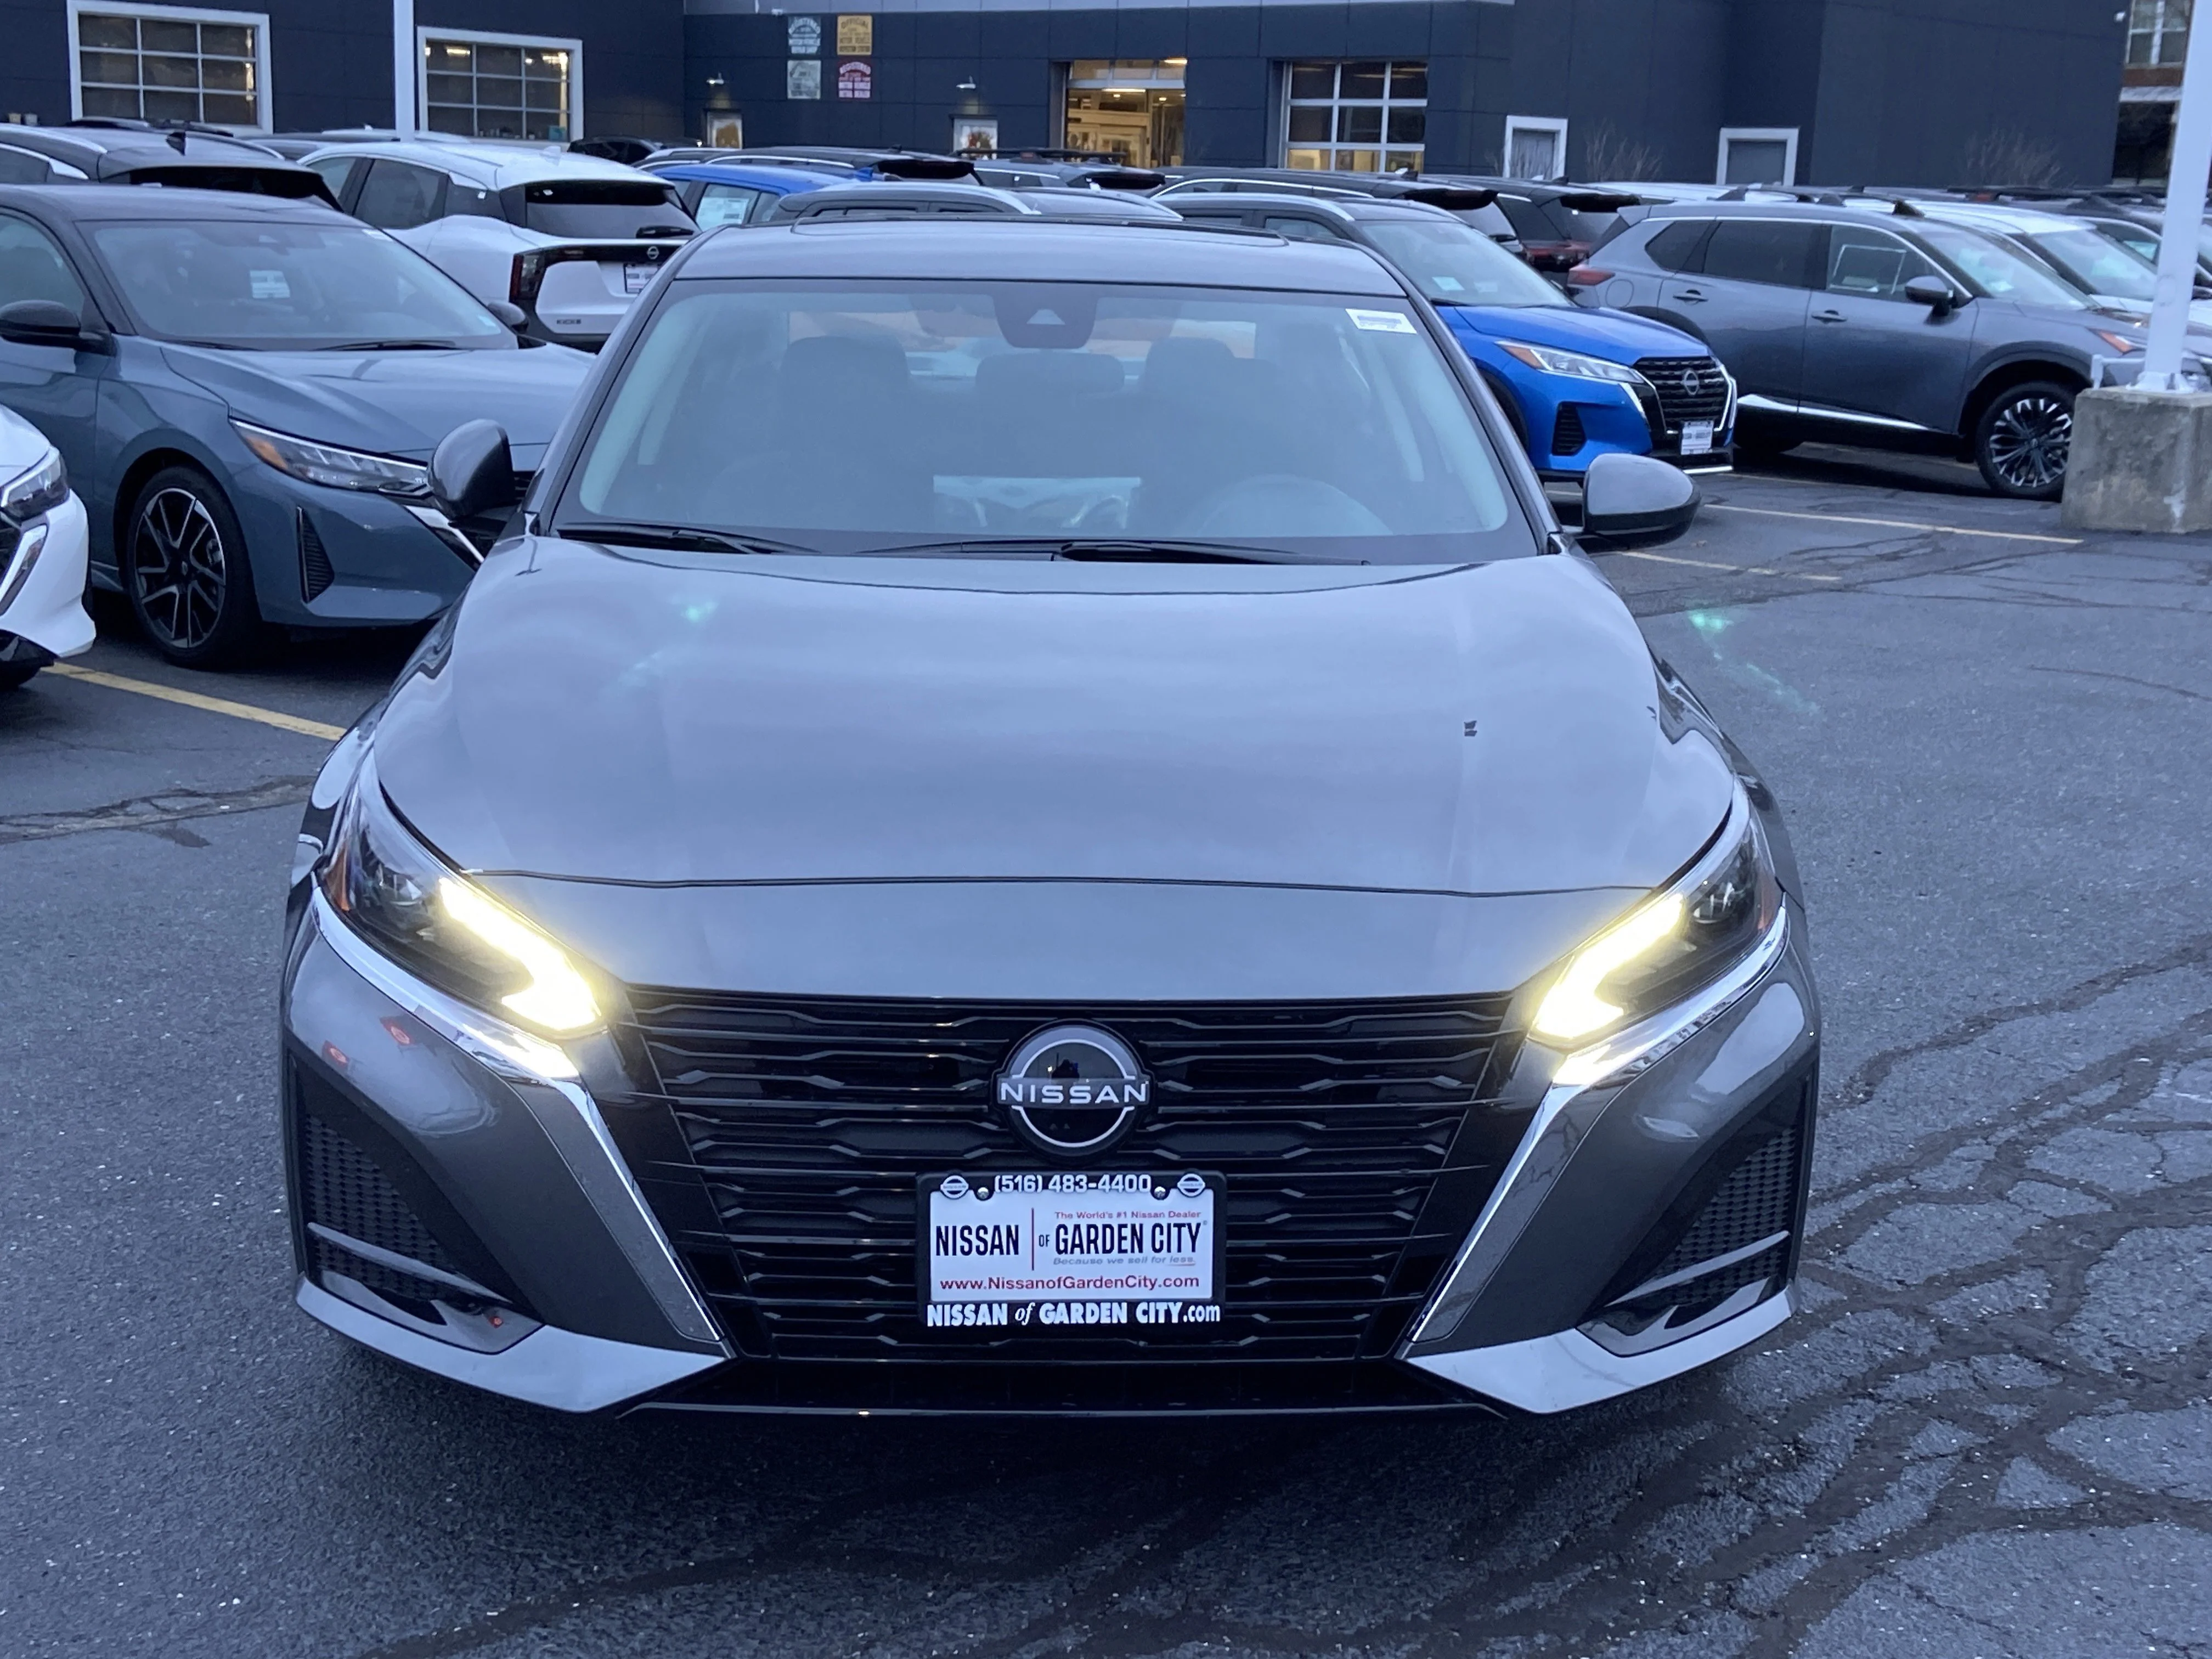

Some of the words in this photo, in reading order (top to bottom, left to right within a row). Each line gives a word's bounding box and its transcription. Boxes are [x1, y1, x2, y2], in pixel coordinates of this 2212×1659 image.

[1001, 1083, 1147, 1104] NISSAN
[994, 1175, 1042, 1193] (516)
[1048, 1174, 1152, 1193] 483-4400
[936, 1224, 1019, 1256] NISSAN
[1039, 1234, 1051, 1247] OF
[1055, 1223, 1144, 1255] GARDEN
[1152, 1222, 1201, 1253] CITY
[1053, 1257, 1103, 1265] Because
[1152, 1256, 1167, 1264] for
[940, 1275, 1199, 1291] www.NissanofGardenCity.com
[927, 1303, 1008, 1327] NISSAN
[1015, 1302, 1036, 1325] of
[1039, 1302, 1127, 1324] GARDEN
[1136, 1301, 1221, 1324] CITY.com
